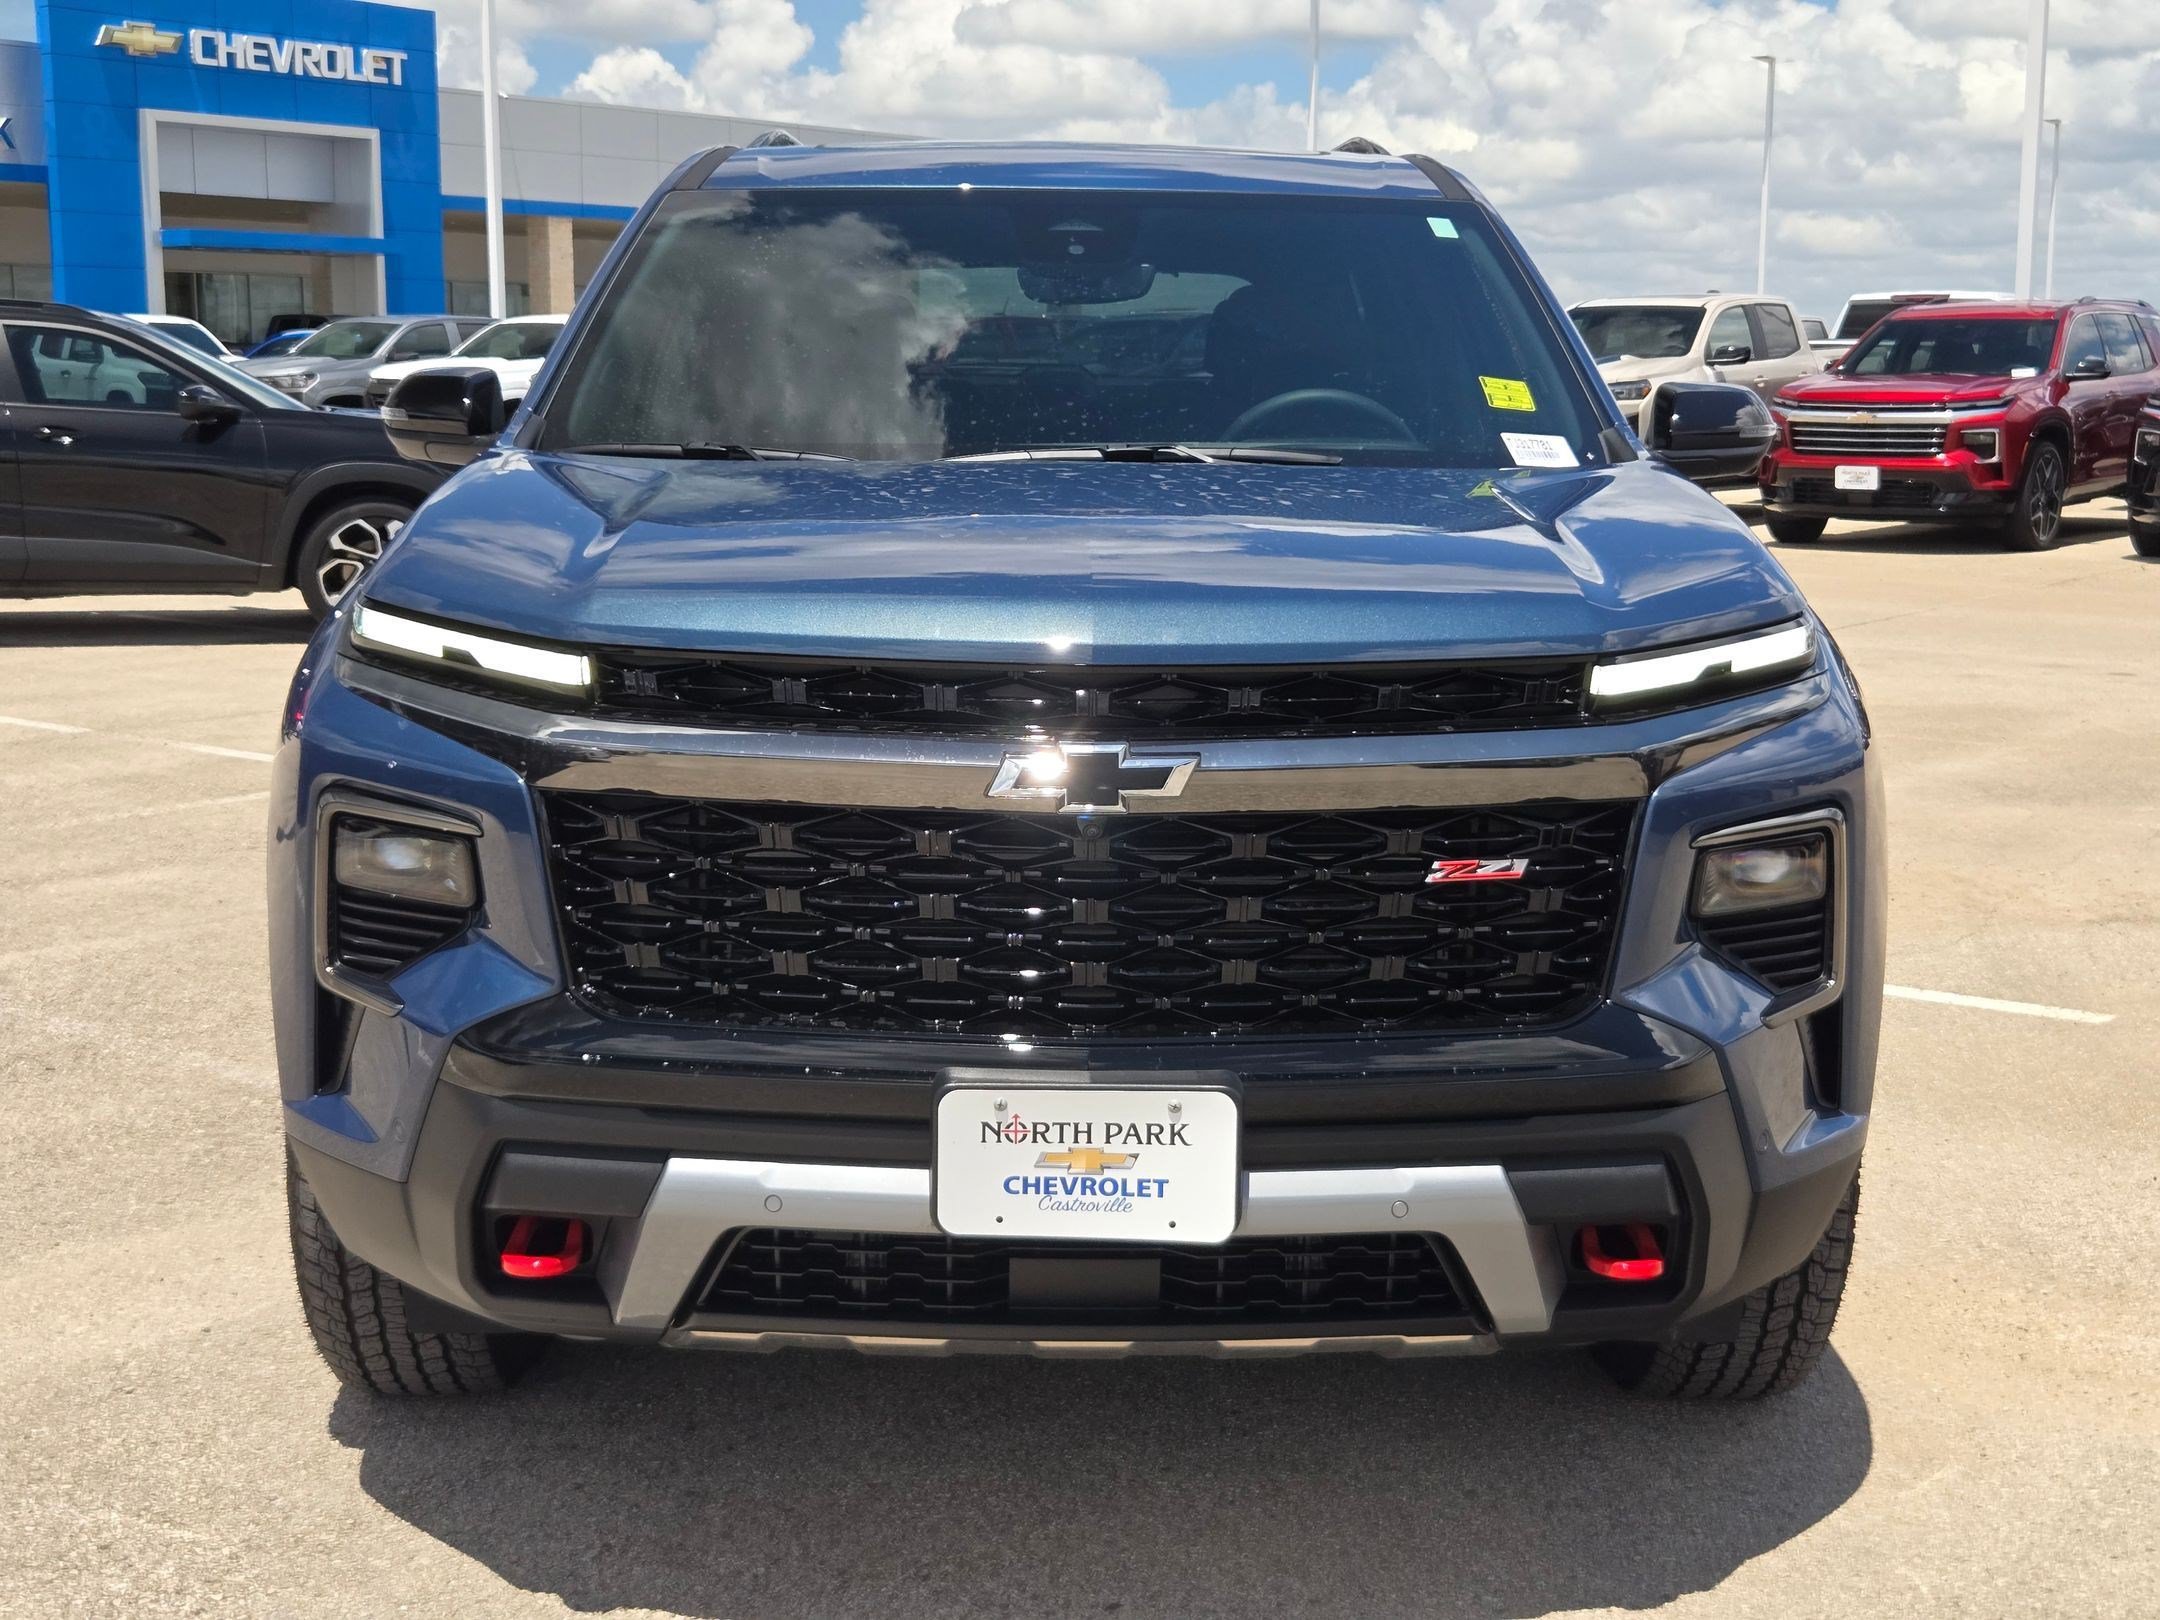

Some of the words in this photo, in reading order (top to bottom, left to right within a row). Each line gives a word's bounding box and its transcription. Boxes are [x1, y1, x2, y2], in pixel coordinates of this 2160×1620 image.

[190, 29, 408, 86] CHEVROLET
[981, 1117, 1093, 1144] NORTH
[1104, 1122, 1193, 1146] PARK
[1003, 1175, 1169, 1198] CHEVROLET
[1038, 1195, 1134, 1213] Castroville
